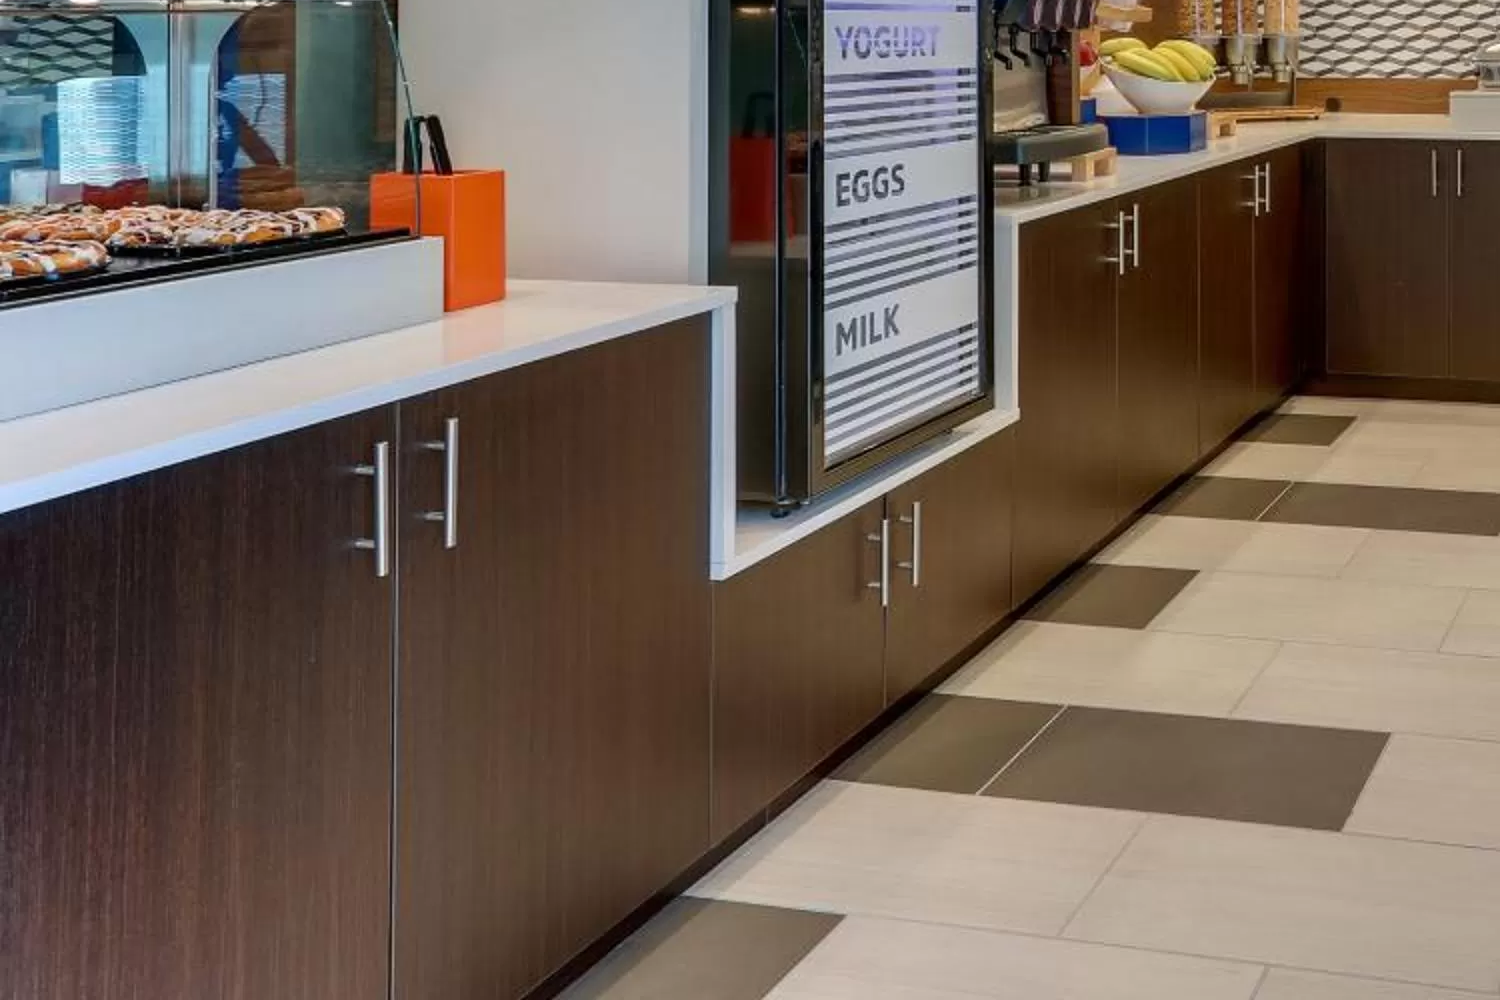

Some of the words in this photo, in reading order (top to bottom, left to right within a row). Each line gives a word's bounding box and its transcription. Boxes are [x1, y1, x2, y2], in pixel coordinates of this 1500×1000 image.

[834, 26, 942, 60] YOGURT
[836, 163, 905, 207] EGGS
[836, 303, 900, 357] MILK
